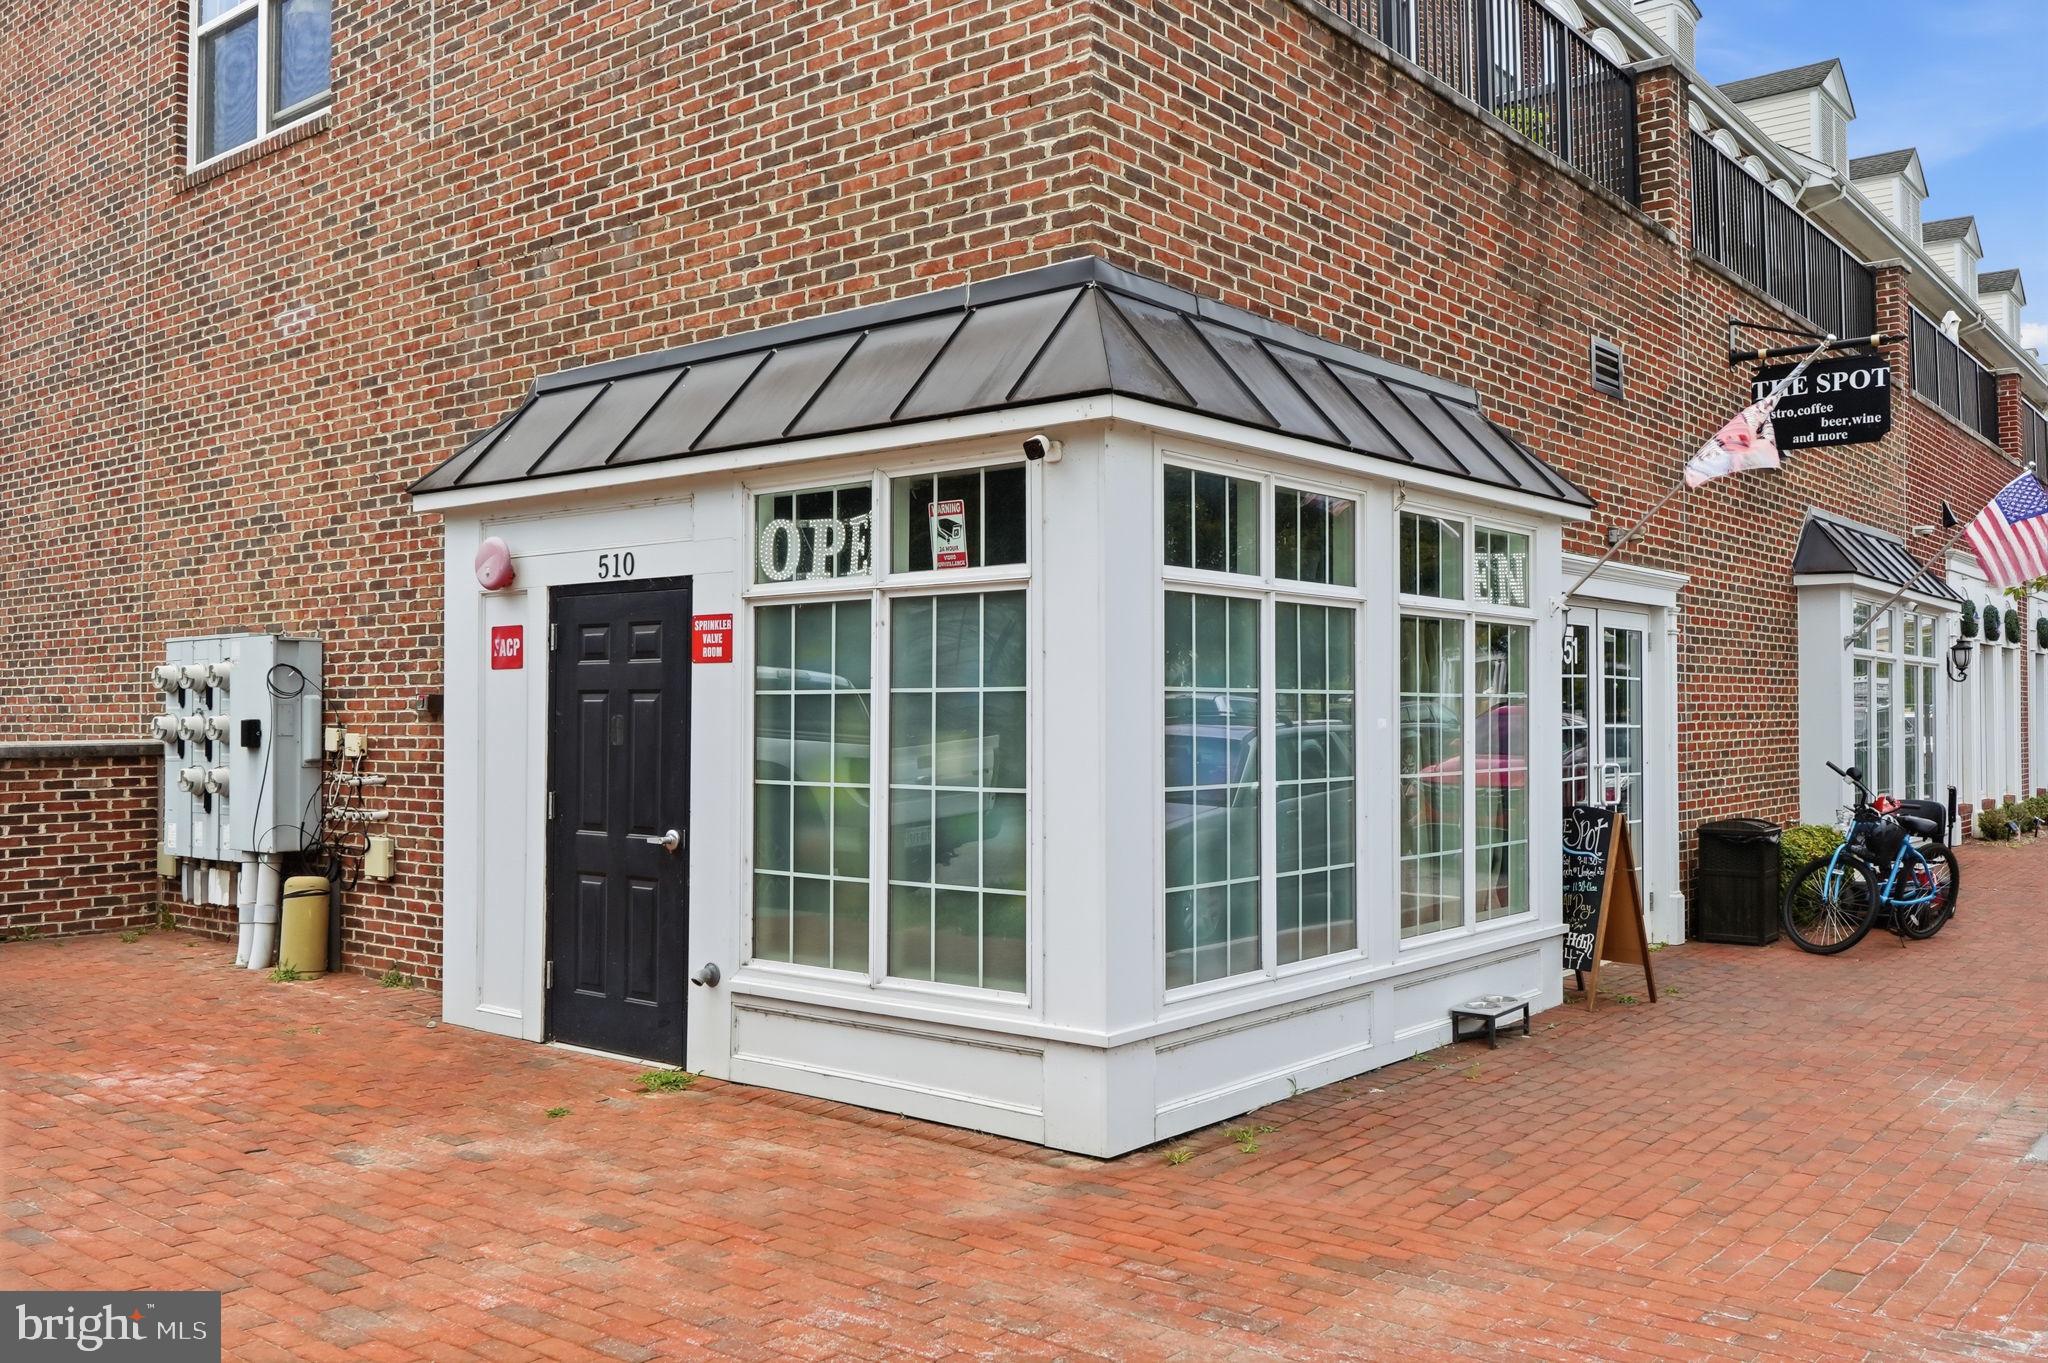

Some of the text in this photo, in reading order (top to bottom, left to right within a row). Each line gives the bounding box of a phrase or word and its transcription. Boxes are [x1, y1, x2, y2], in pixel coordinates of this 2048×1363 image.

[1816, 367, 1890, 393] SPOT
[1769, 402, 1834, 420] stro,coffee
[1793, 431, 1848, 443] and more
[760, 509, 873, 580] OPE
[598, 552, 635, 579] 510
[694, 619, 732, 631] SPRINKLER
[702, 633, 723, 644] VALVE
[702, 646, 723, 658] ROOM
